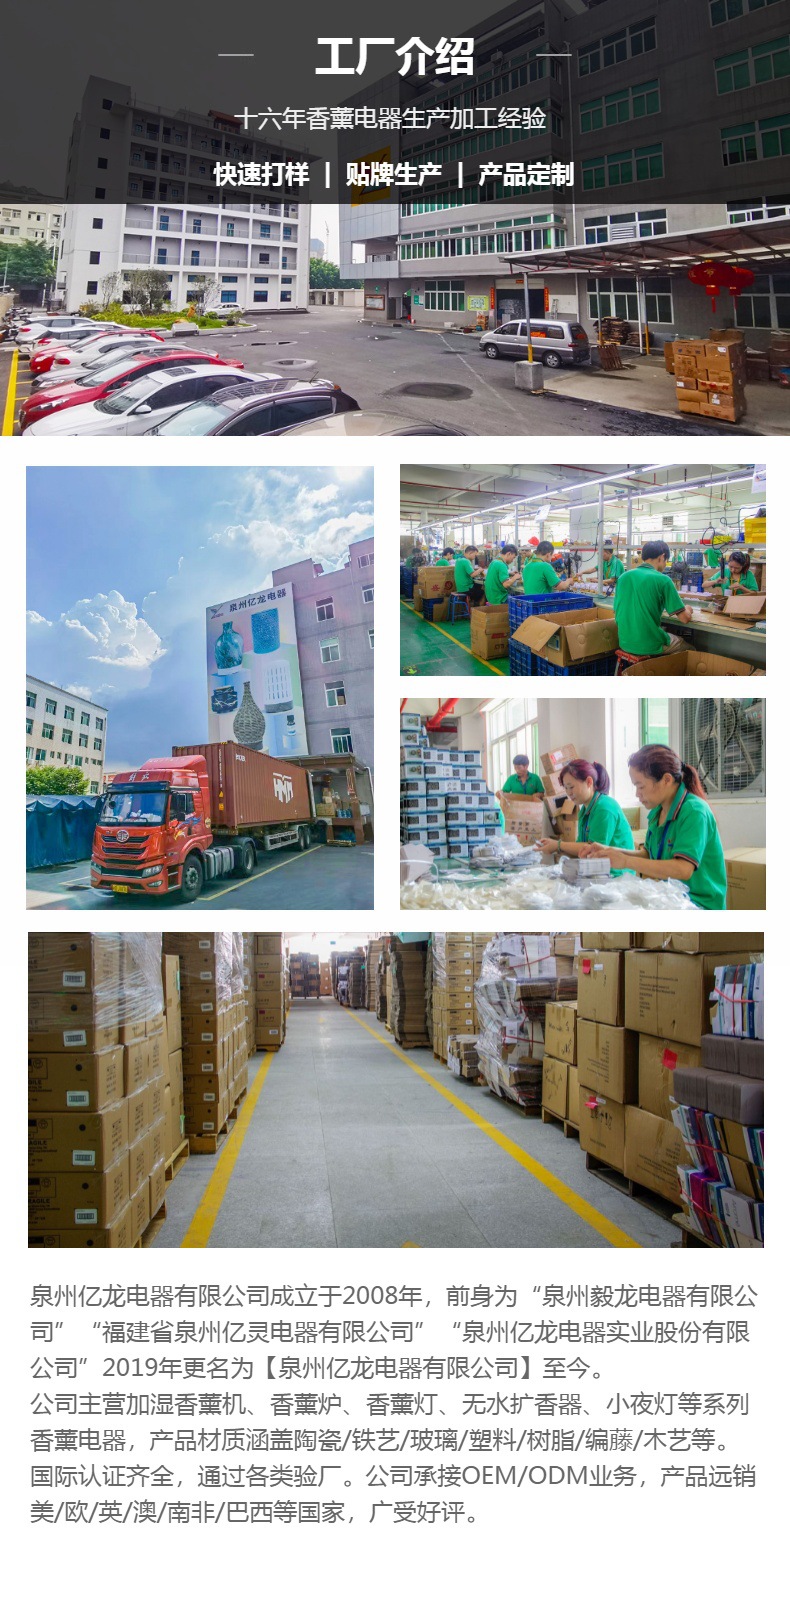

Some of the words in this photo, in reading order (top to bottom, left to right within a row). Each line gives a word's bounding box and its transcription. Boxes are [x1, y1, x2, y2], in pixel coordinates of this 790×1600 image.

[229, 588, 287, 612] 泉州亿龙电器
